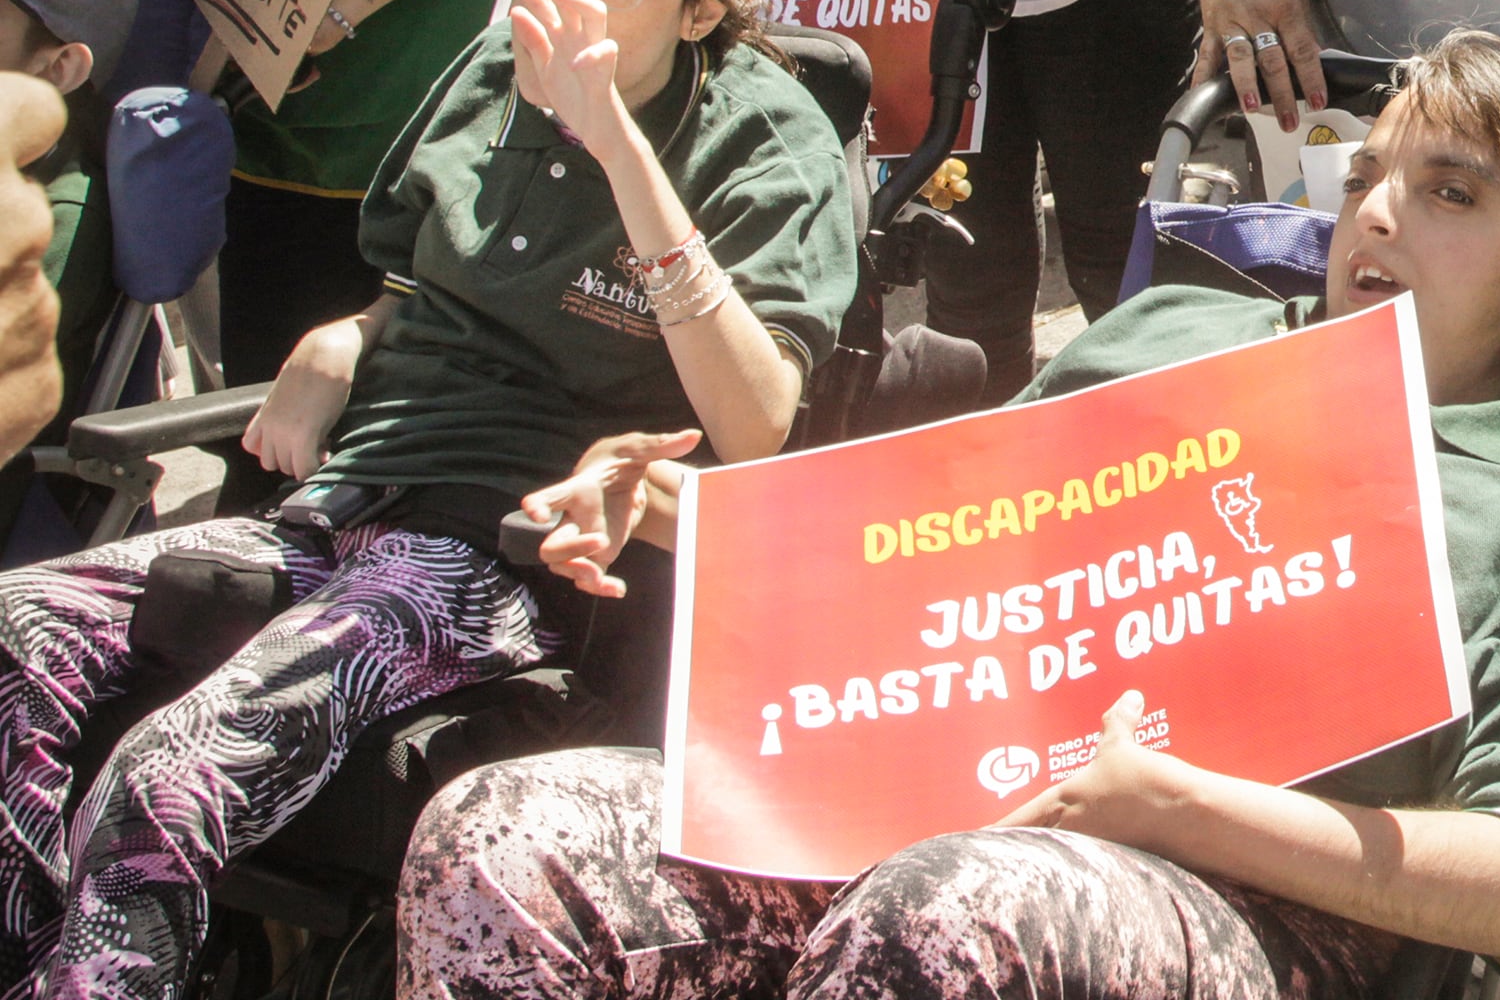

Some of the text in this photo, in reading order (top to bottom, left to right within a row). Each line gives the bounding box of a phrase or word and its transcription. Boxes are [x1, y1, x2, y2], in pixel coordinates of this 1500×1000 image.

[571, 267, 650, 314] Nantu
[863, 427, 1242, 564] DISCAPACIDAD
[919, 530, 1216, 650] JUSTICIA,
[759, 534, 1356, 756] ¡BASTA DE QUITAS!
[1047, 737, 1084, 756] FORO
[1048, 722, 1170, 771] DISCADAD
